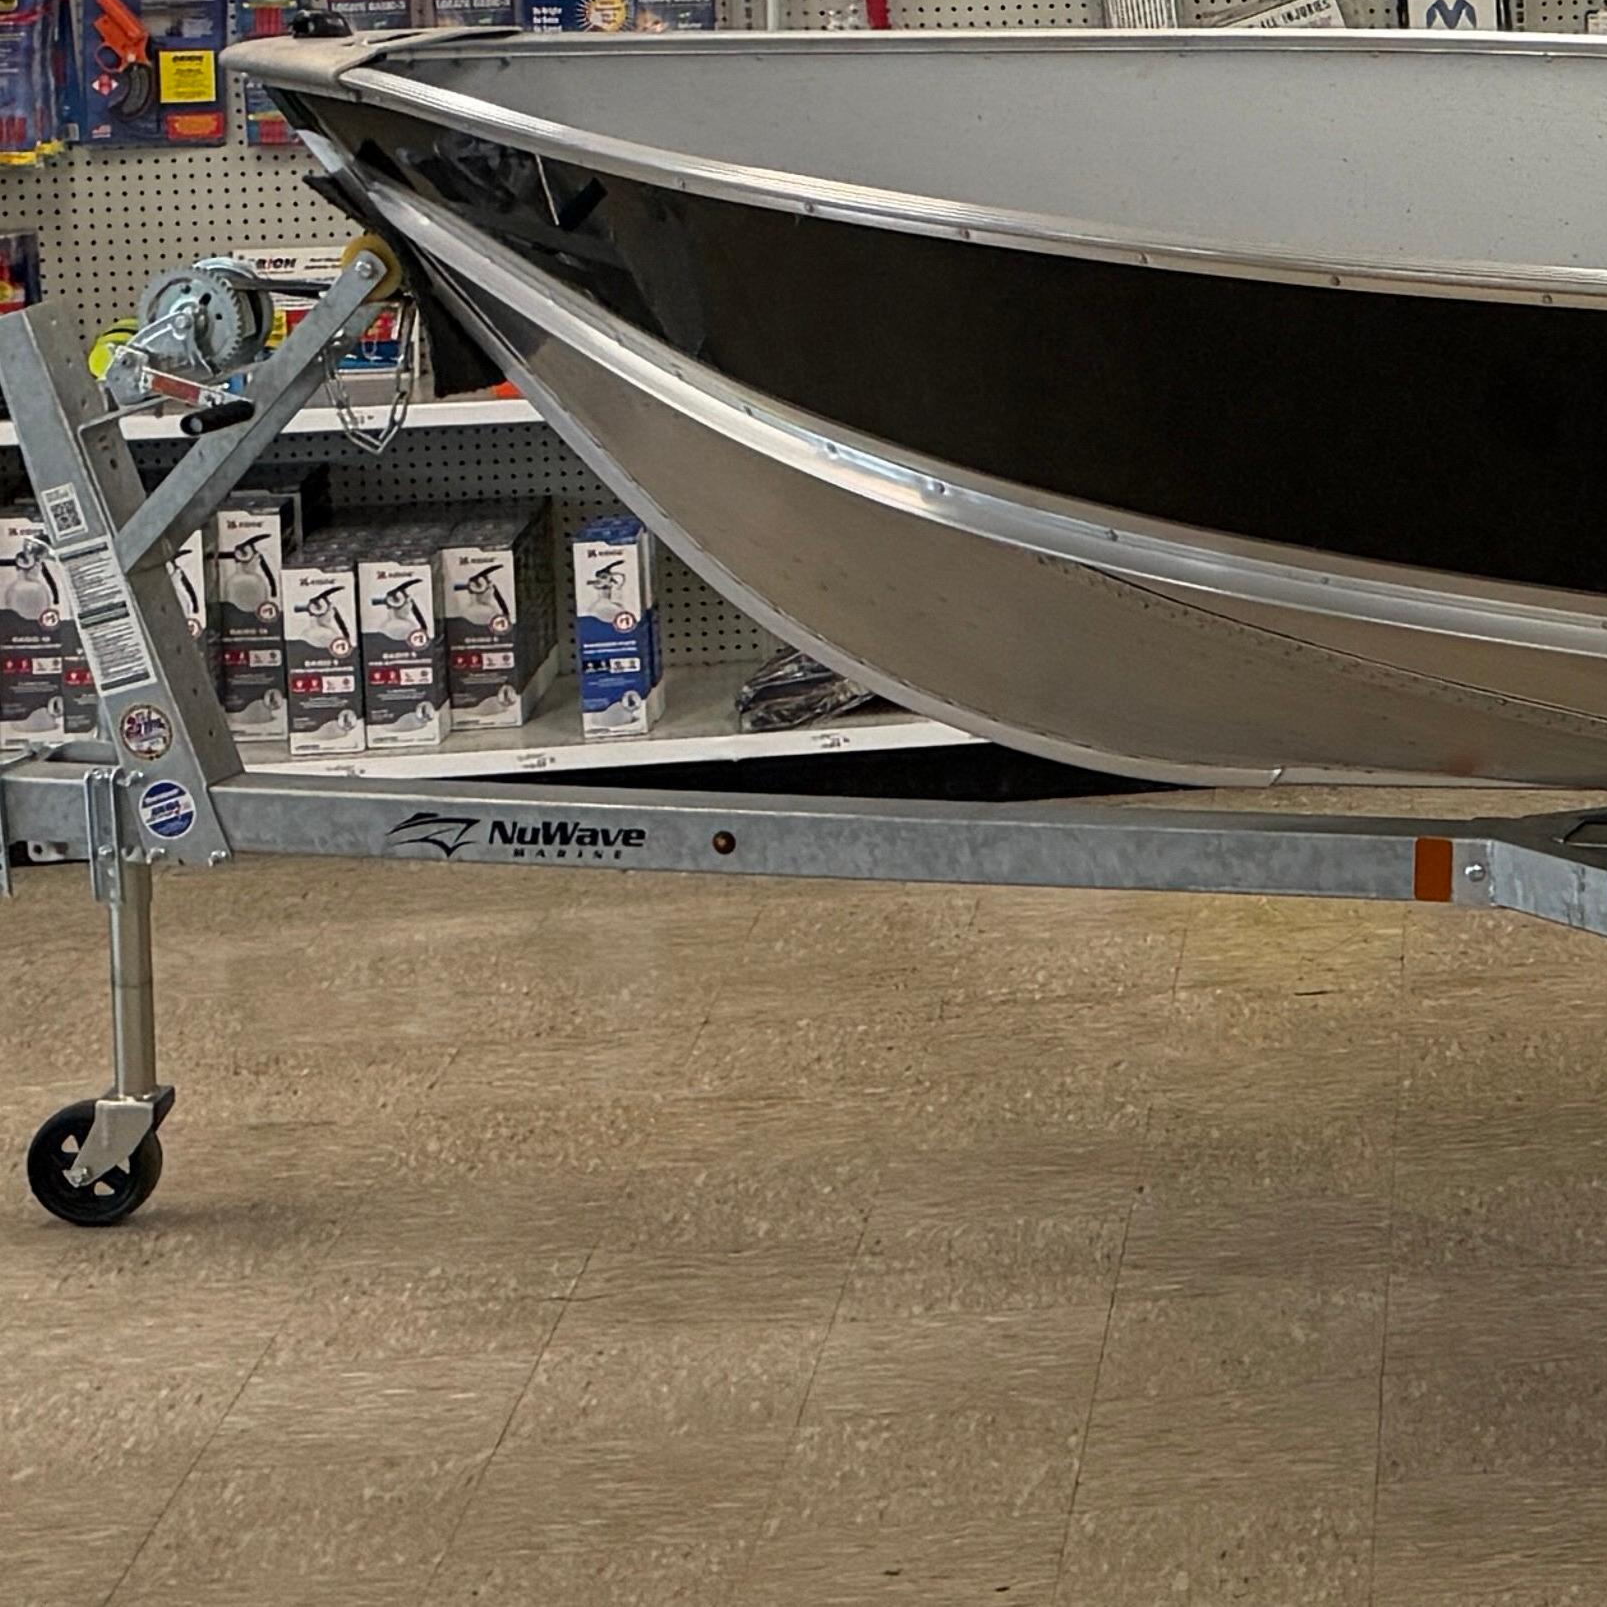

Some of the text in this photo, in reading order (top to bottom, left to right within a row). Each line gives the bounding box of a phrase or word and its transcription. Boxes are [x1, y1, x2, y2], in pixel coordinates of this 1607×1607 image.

[256, 258, 298, 269] RION
[488, 820, 647, 847] NuWave
[513, 848, 622, 859] MARINE
